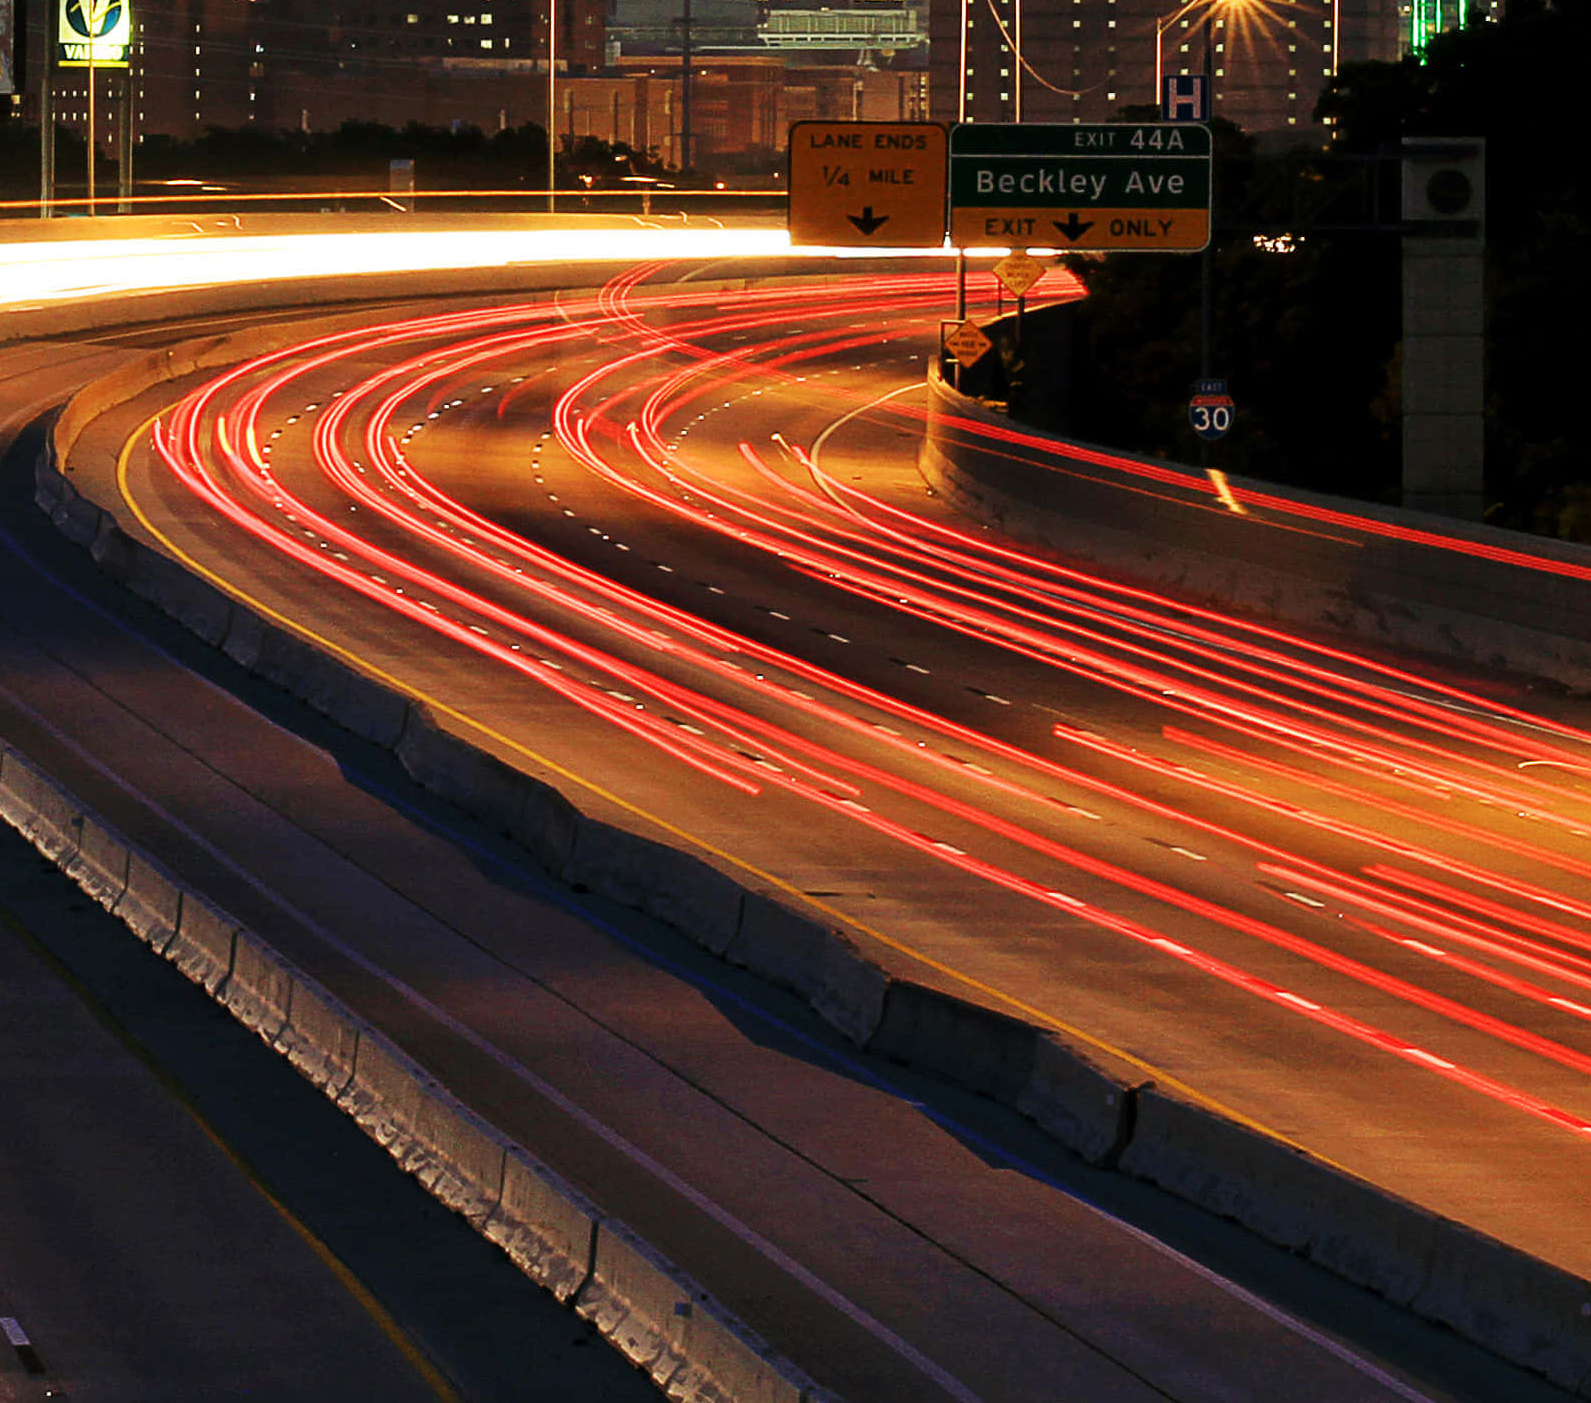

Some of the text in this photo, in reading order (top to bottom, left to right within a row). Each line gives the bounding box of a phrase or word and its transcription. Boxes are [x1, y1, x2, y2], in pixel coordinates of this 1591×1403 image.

[1168, 77, 1202, 119] H
[810, 134, 928, 150] LANE ENDS
[1074, 129, 1184, 150] EXIT 44A
[869, 169, 914, 185] MILE
[977, 169, 1185, 200] Beckley Ave
[985, 218, 1173, 237] EXIT ONLY
[1194, 407, 1230, 431] 30
